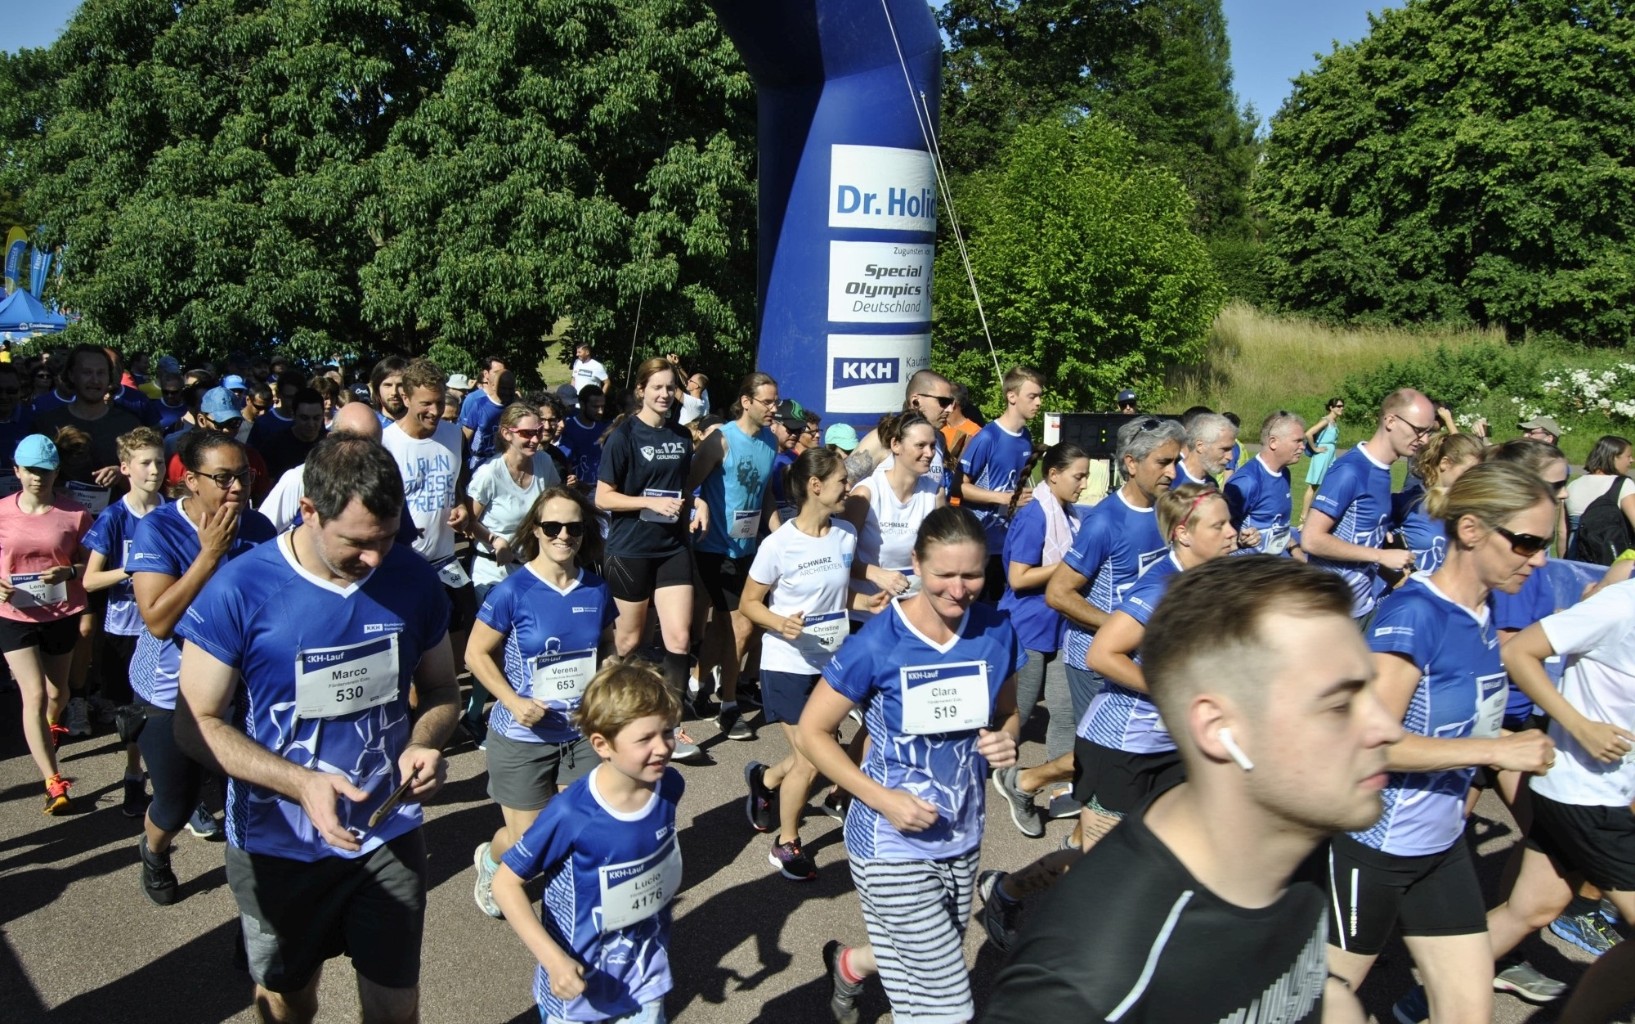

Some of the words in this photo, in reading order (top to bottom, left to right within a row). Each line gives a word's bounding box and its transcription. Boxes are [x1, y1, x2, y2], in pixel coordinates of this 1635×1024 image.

[837, 185, 881, 214] Dr.
[865, 264, 922, 279] Special
[845, 282, 921, 298] Olympics
[853, 300, 920, 313] Deutschland
[843, 362, 892, 379] KKH
[662, 442, 685, 454] 125
[417, 454, 451, 477] RUN
[880, 521, 909, 529] SCHWARZ
[798, 556, 832, 570] SCHWARZ
[800, 563, 842, 577] ARCHITEKTEN
[813, 624, 840, 633] Christine
[332, 667, 367, 680] Marco
[552, 667, 578, 675] Verena
[908, 670, 939, 680] KKH-Lauf
[556, 680, 575, 690] 653
[336, 685, 364, 702] 530
[931, 688, 957, 697] Clara
[934, 706, 957, 719] 519
[609, 865, 645, 880] KKH-Lauf
[635, 873, 661, 890] Lucio
[632, 887, 662, 909] 4176
